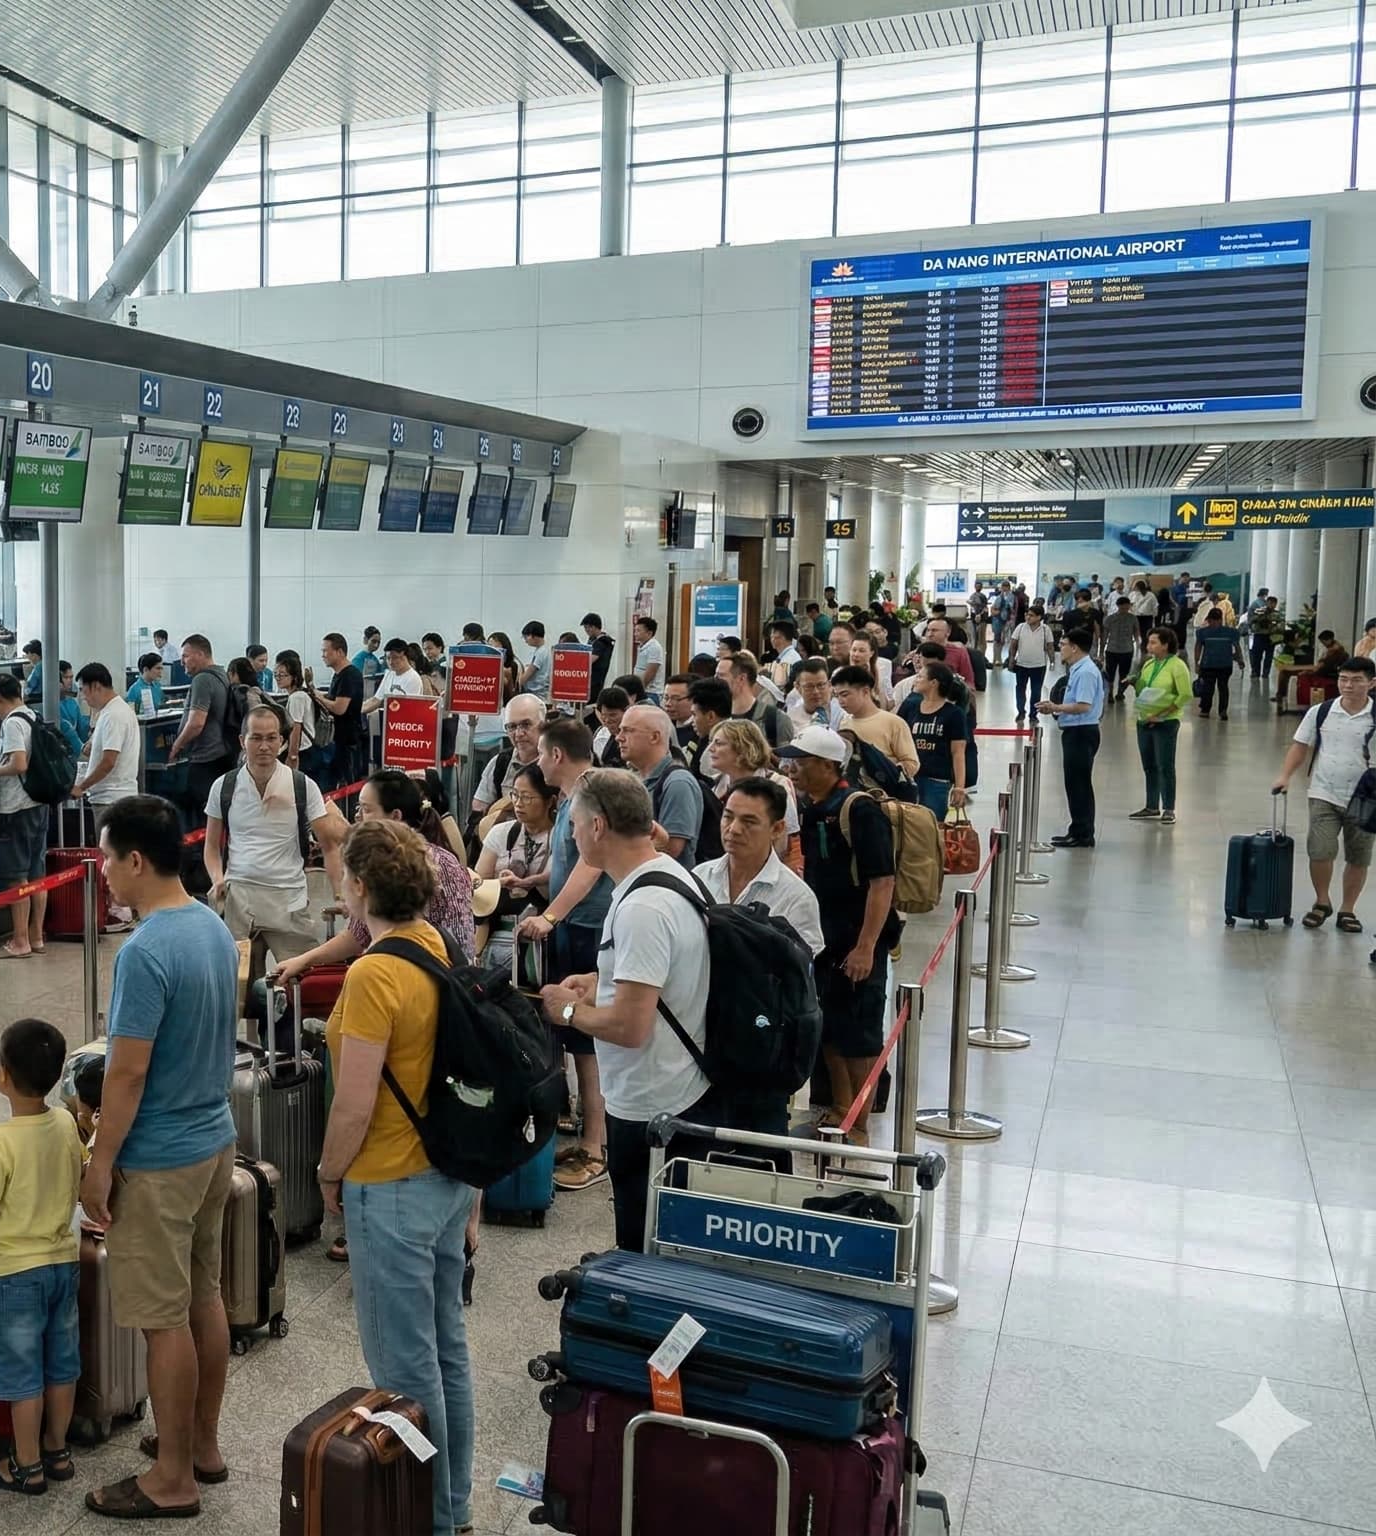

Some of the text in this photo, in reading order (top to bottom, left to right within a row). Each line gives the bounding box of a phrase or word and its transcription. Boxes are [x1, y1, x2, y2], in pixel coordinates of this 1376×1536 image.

[923, 239, 1186, 271] DA NANG INTERNATIONAL AIRPORT
[31, 361, 52, 391] 20
[143, 380, 160, 408] 21
[207, 392, 222, 417] 22
[776, 522, 791, 535] 15
[388, 738, 432, 749] PRIORITY
[705, 1214, 843, 1258] PRIORITY
